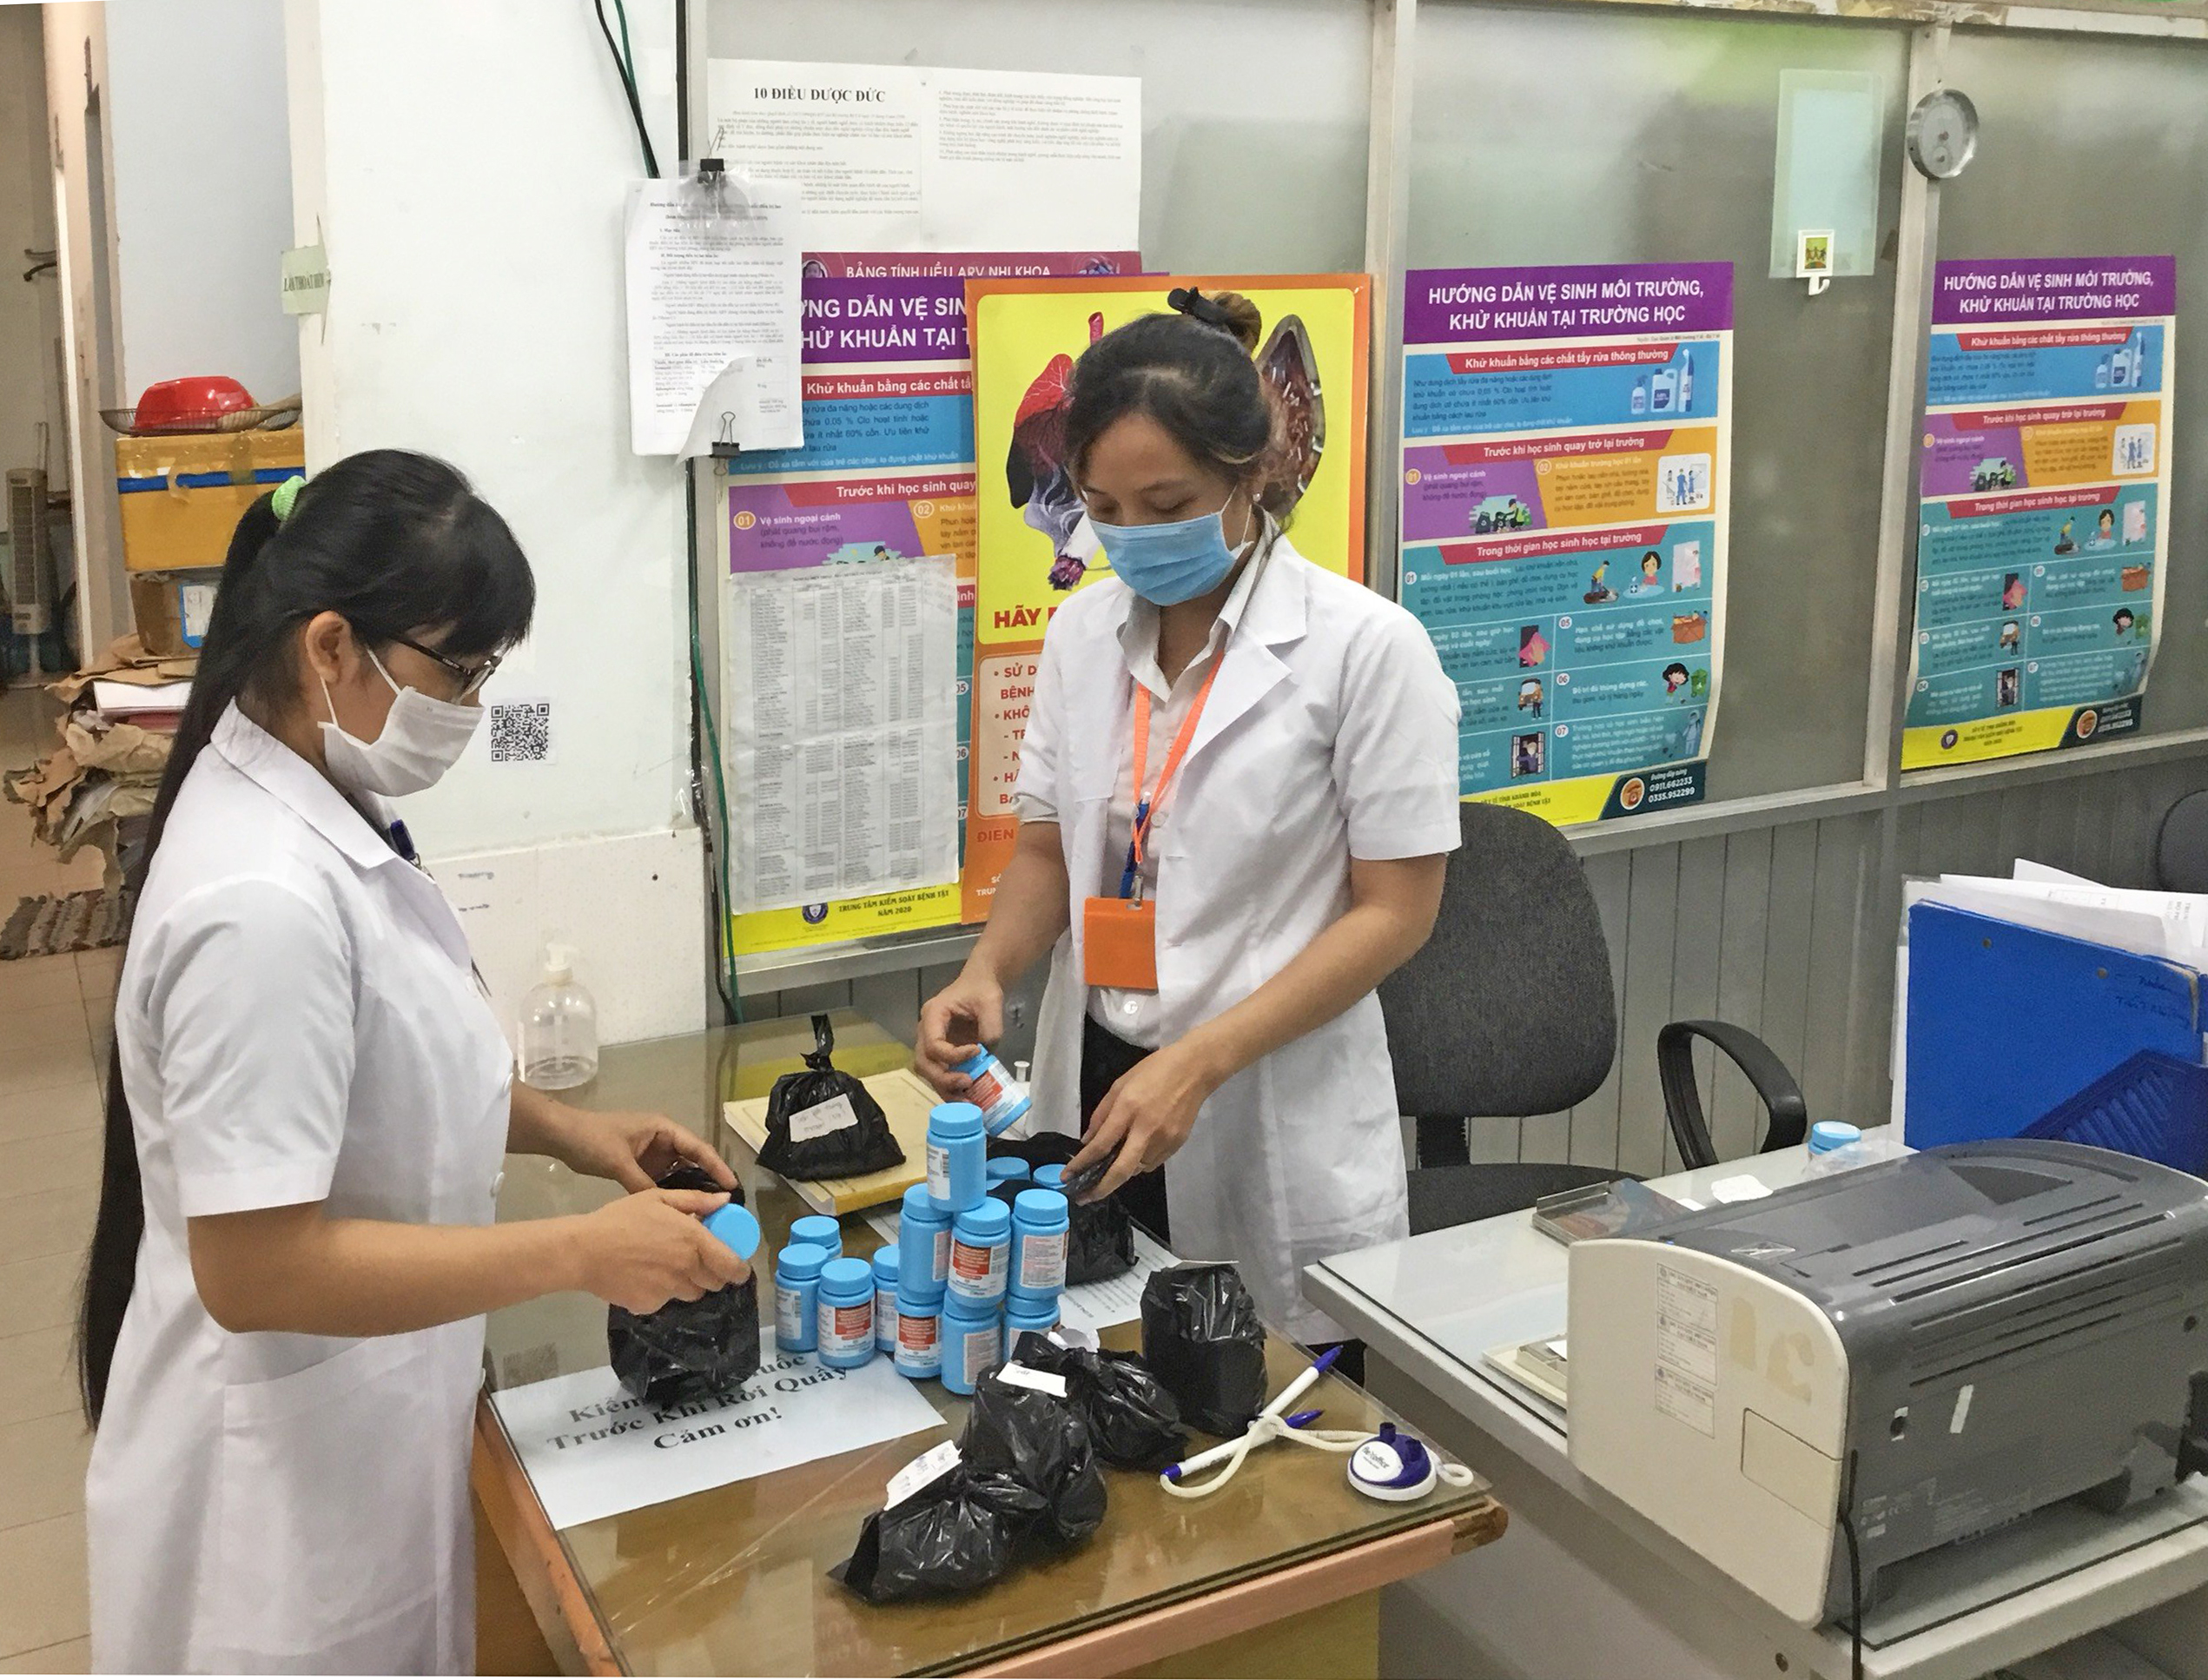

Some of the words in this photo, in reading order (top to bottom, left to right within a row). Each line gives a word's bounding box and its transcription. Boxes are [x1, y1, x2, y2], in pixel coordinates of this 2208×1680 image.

[754, 88, 768, 99] 10
[810, 88, 852, 103] DƯỢC
[856, 87, 885, 103] ĐỨC
[846, 261, 886, 277] BẢNG
[891, 263, 919, 277] TÍNH
[988, 266, 1011, 276] NHI
[1015, 266, 1050, 276] KHOA
[1944, 273, 1997, 291] HƯỚNG
[2000, 271, 2026, 289] DẪN
[2027, 273, 2042, 291] VỆ
[2044, 273, 2072, 288] SINH
[2075, 270, 2099, 288] MÔI
[1428, 285, 1496, 304] HƯỚNG
[1501, 281, 1534, 302] DẪN
[1537, 282, 1557, 304] VỆ
[1561, 282, 1597, 301] SINH
[1601, 279, 1630, 298] MÔI
[1635, 280, 1704, 298] TRƯỜNG,
[848, 294, 893, 318] DẪN
[900, 295, 928, 321] VỆ
[1959, 294, 1992, 314] KHỬ
[2037, 296, 2055, 314] TẠI
[2058, 293, 2112, 309] TRƯỜNG
[2115, 294, 2139, 309] HỌC
[1449, 309, 1490, 330] KHỬ
[1551, 309, 1576, 329] TẠI
[1580, 306, 1649, 325] TRƯỜNG
[1653, 305, 1685, 324] HỌC
[840, 325, 916, 348] KHUẨN
[923, 327, 955, 350] TẠI
[1541, 354, 1554, 365] các
[1610, 349, 1636, 363] thông
[807, 381, 834, 394] Khử
[836, 379, 874, 394] khuẩn
[877, 379, 907, 394] bằng
[910, 380, 930, 391] các
[934, 377, 959, 390] chất
[1484, 446, 1511, 457] Trước
[1513, 445, 1525, 455] khi
[1527, 444, 1542, 455] học
[1544, 442, 1562, 453] sinh
[1563, 441, 1586, 453] quay
[1603, 438, 1614, 450] lại
[1616, 437, 1644, 447] trường
[836, 485, 874, 497] Trước
[876, 484, 895, 495] khi
[898, 483, 919, 496] học
[922, 480, 947, 493] sinh
[949, 480, 975, 493] quay
[737, 515, 750, 526] 01
[773, 515, 792, 525] sinh
[917, 505, 930, 516] 02
[1478, 546, 1504, 558] Trong
[1504, 543, 1522, 553] thời
[1524, 543, 1541, 555] gian
[1542, 539, 1558, 552] học
[1560, 537, 1580, 547] sinh
[1582, 535, 1598, 547] học
[1613, 532, 1642, 543] trường
[994, 605, 1041, 629] HÃY
[1004, 663, 1022, 678] SỬ
[839, 903, 862, 912] TRUNG
[863, 900, 877, 909] TÂM
[917, 892, 935, 901] BỆNH
[546, 1416, 645, 1451] Trước
[652, 1399, 708, 1425] Khi
[774, 1366, 848, 1393] Quầy
[734, 1406, 783, 1430] ơn!
